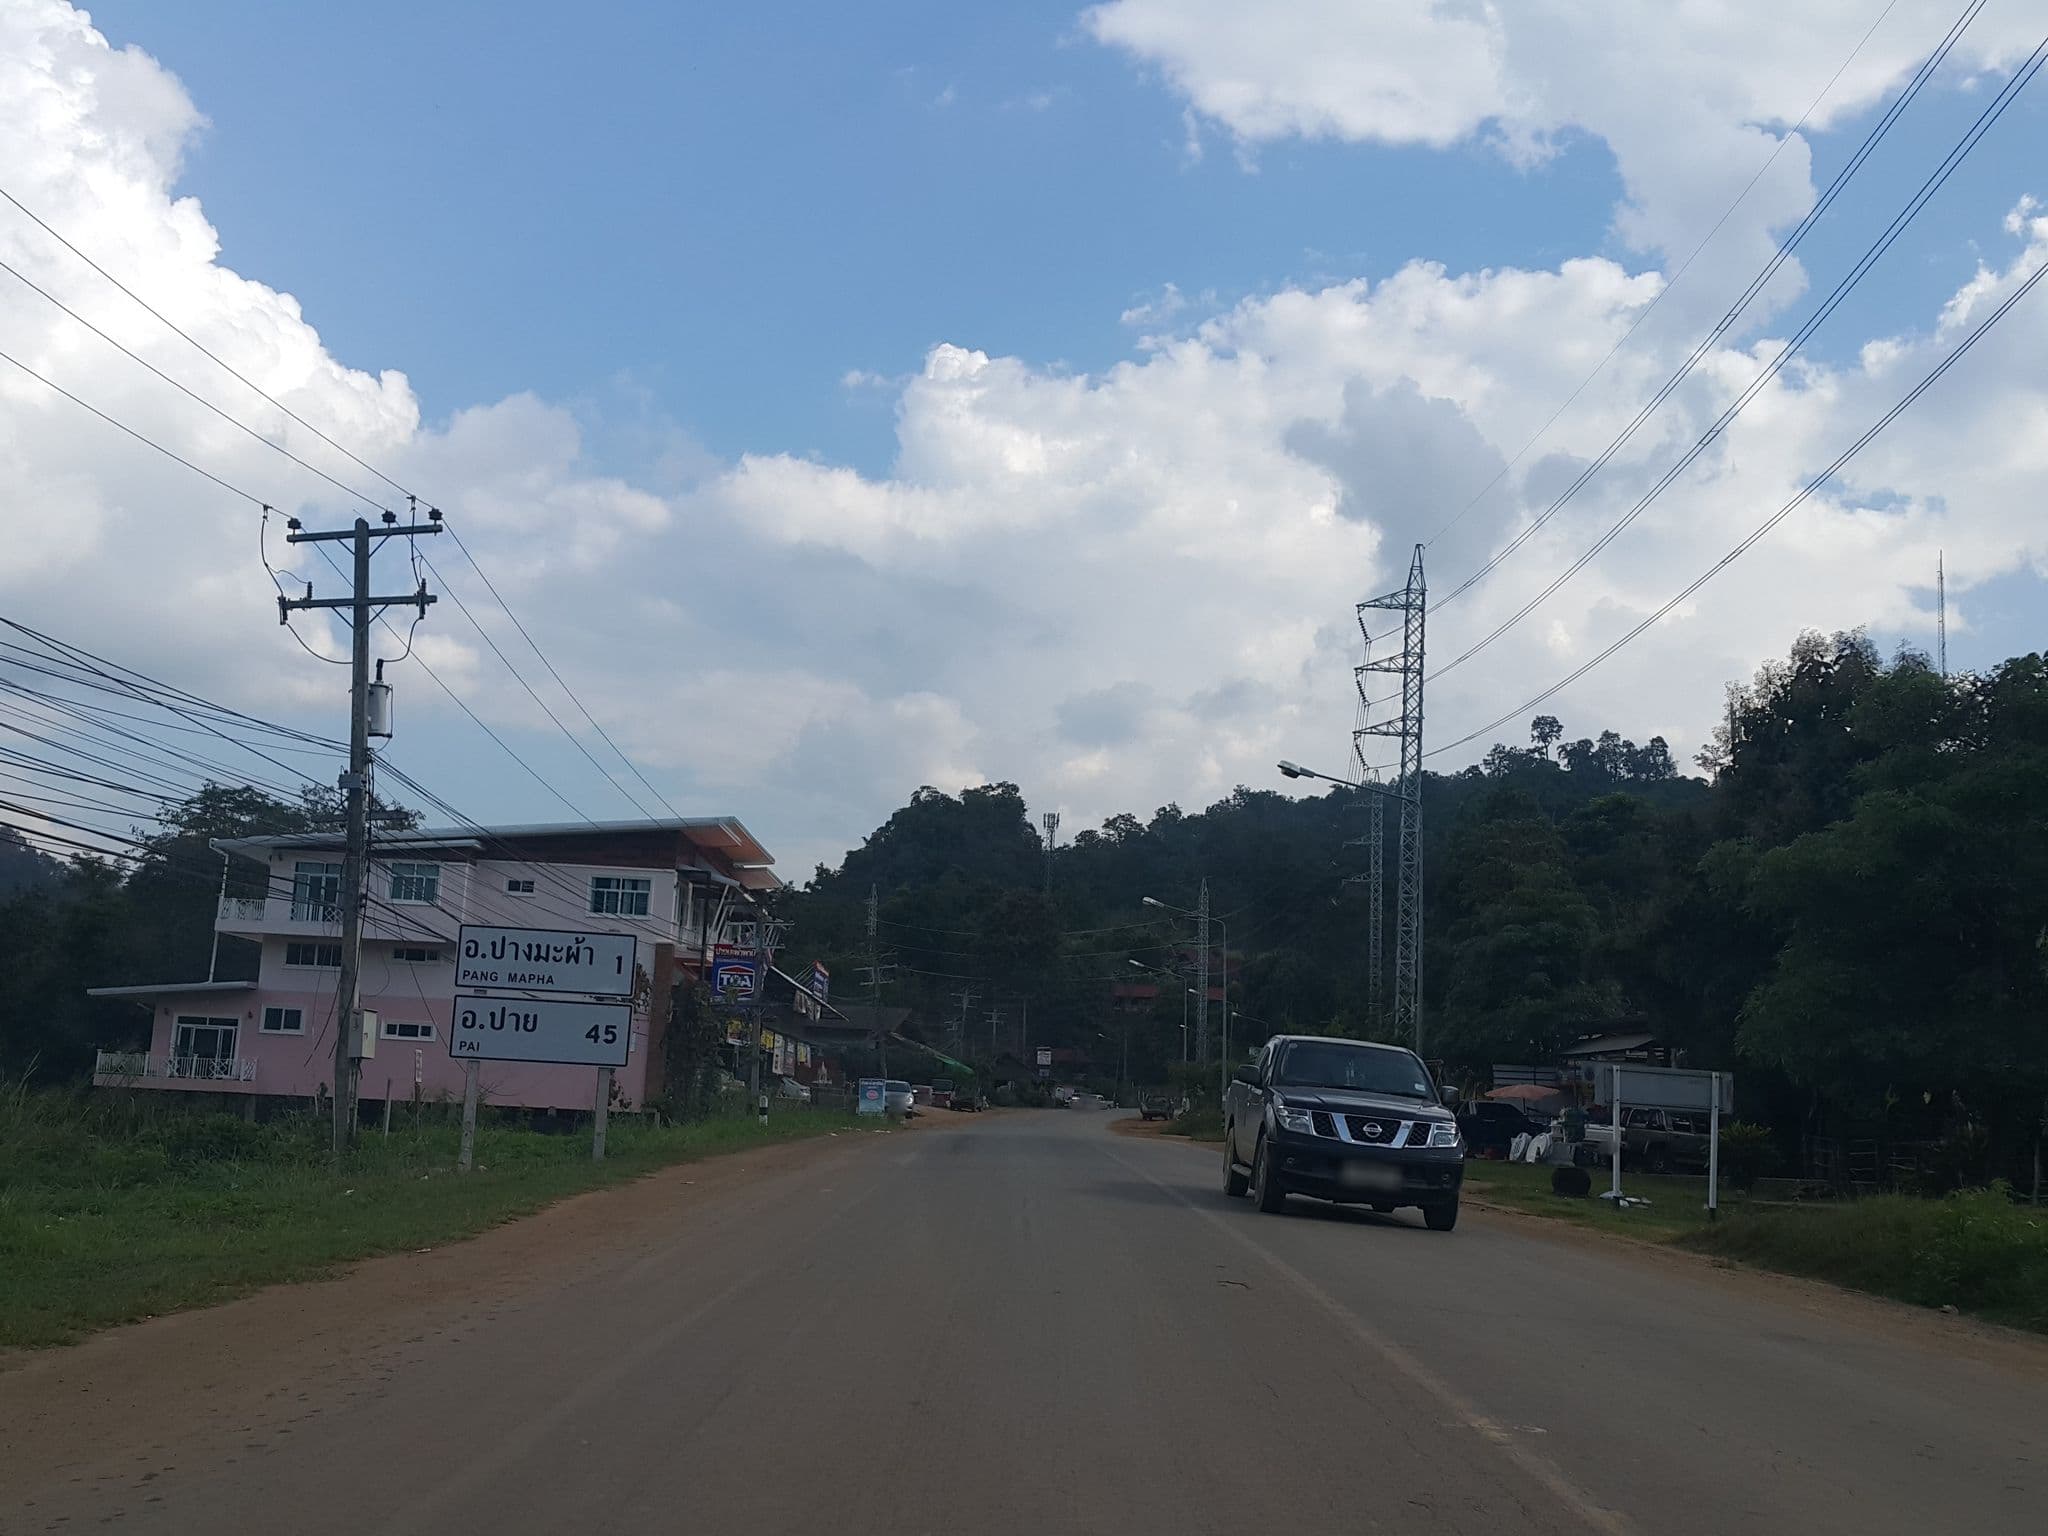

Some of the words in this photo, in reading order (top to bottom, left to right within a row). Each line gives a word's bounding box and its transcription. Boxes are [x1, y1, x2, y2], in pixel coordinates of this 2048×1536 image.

[465, 935, 594, 966] อ.ปางมะผ้า
[615, 955, 623, 975] 1
[462, 969, 499, 982] PANG
[507, 972, 555, 985] MAPHA
[461, 1006, 538, 1033] อ.ปาย
[585, 1024, 618, 1045] 45
[458, 1040, 480, 1052] PAI
